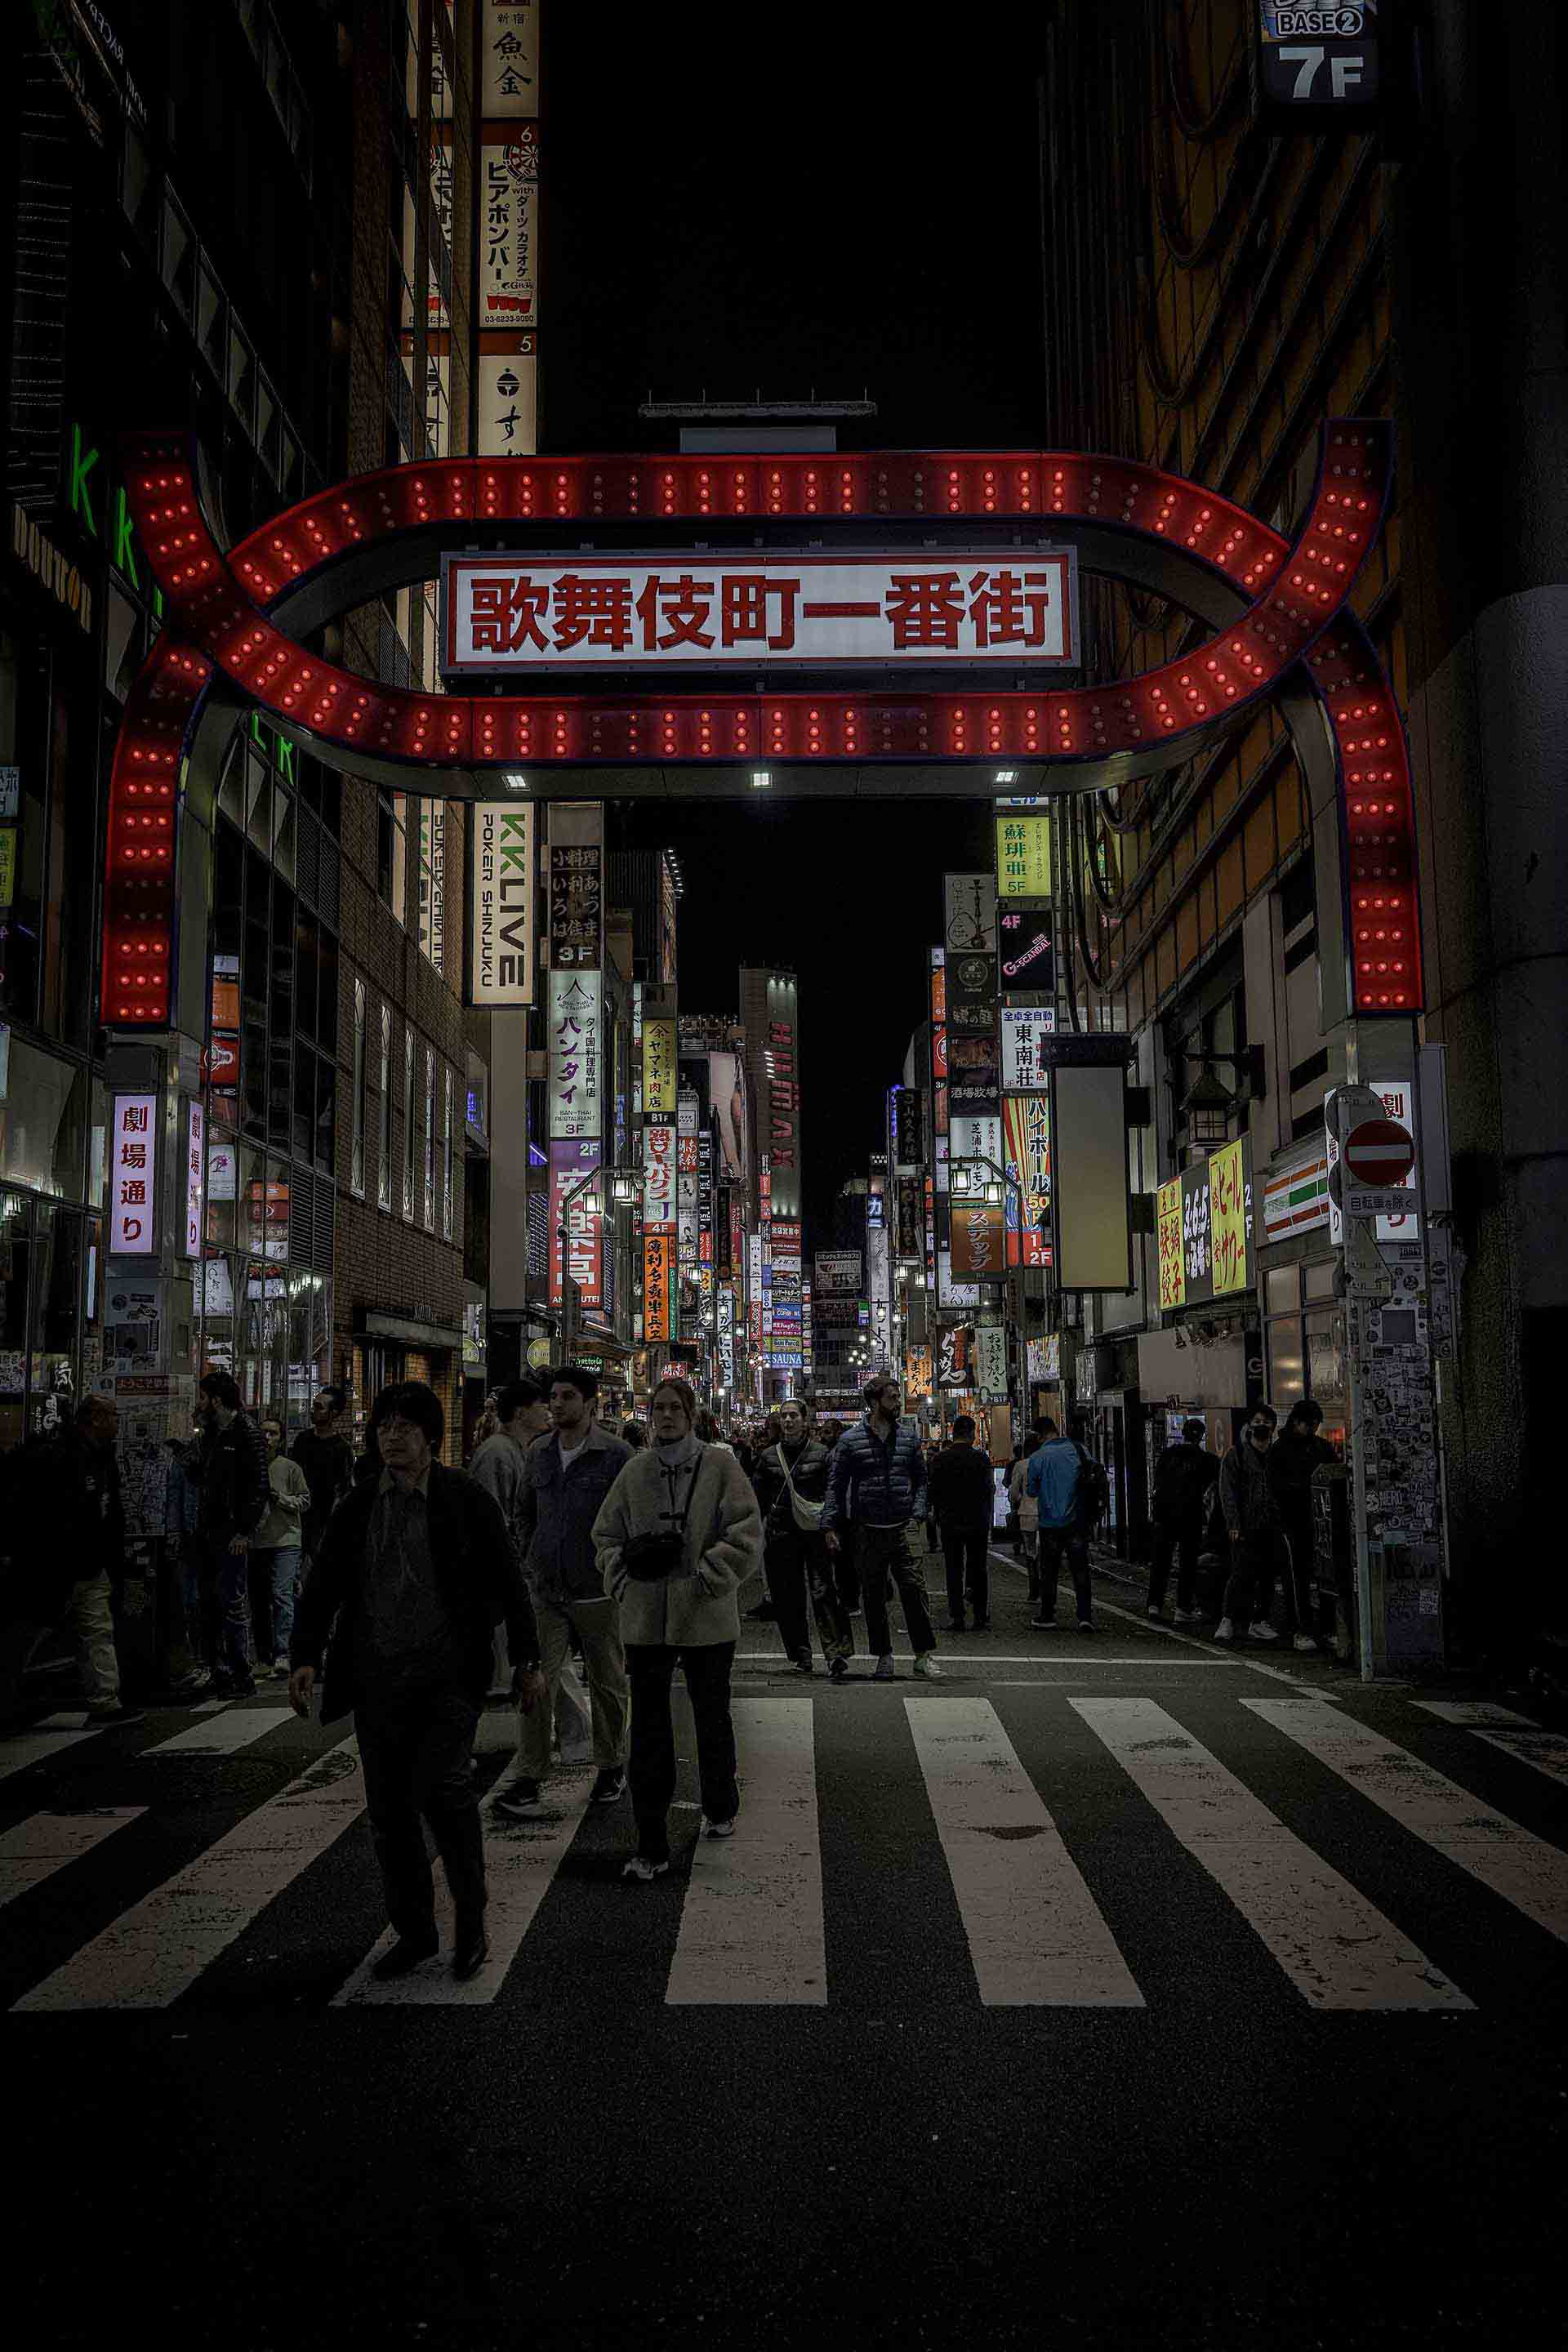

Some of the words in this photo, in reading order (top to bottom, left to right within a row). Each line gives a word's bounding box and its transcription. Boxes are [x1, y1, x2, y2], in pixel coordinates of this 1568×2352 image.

[497, 13, 529, 26] 新宿
[492, 31, 532, 96] 魚金
[1279, 46, 1364, 98] 7F
[520, 124, 532, 142] 6
[488, 162, 510, 280] ビアポンバー
[516, 232, 529, 278] カラオケ
[520, 336, 531, 352] 5
[470, 572, 1047, 653] 歌舞伎町一番街
[483, 814, 493, 882] POKER
[1008, 882, 1026, 892] 5F
[482, 890, 493, 987] SHINJUKU
[559, 947, 594, 961] 3F
[1004, 1011, 1052, 1021] 全卓全自動
[557, 1017, 581, 1104] バンタイ
[586, 1018, 595, 1098] タイ国料理専門店
[648, 1041, 662, 1108] ヤマネ肉店
[1014, 1024, 1033, 1087] 東南荘
[565, 1125, 585, 1134] 3F
[651, 1113, 669, 1122] B1F
[580, 1143, 599, 1156] 2F
[1027, 1102, 1050, 1192] ハイボール
[121, 1106, 148, 1241] 劇場通り
[556, 1168, 595, 1285] 安楽亭
[1351, 1195, 1412, 1210] 自転車を除く
[772, 1353, 802, 1364] SAUNA
